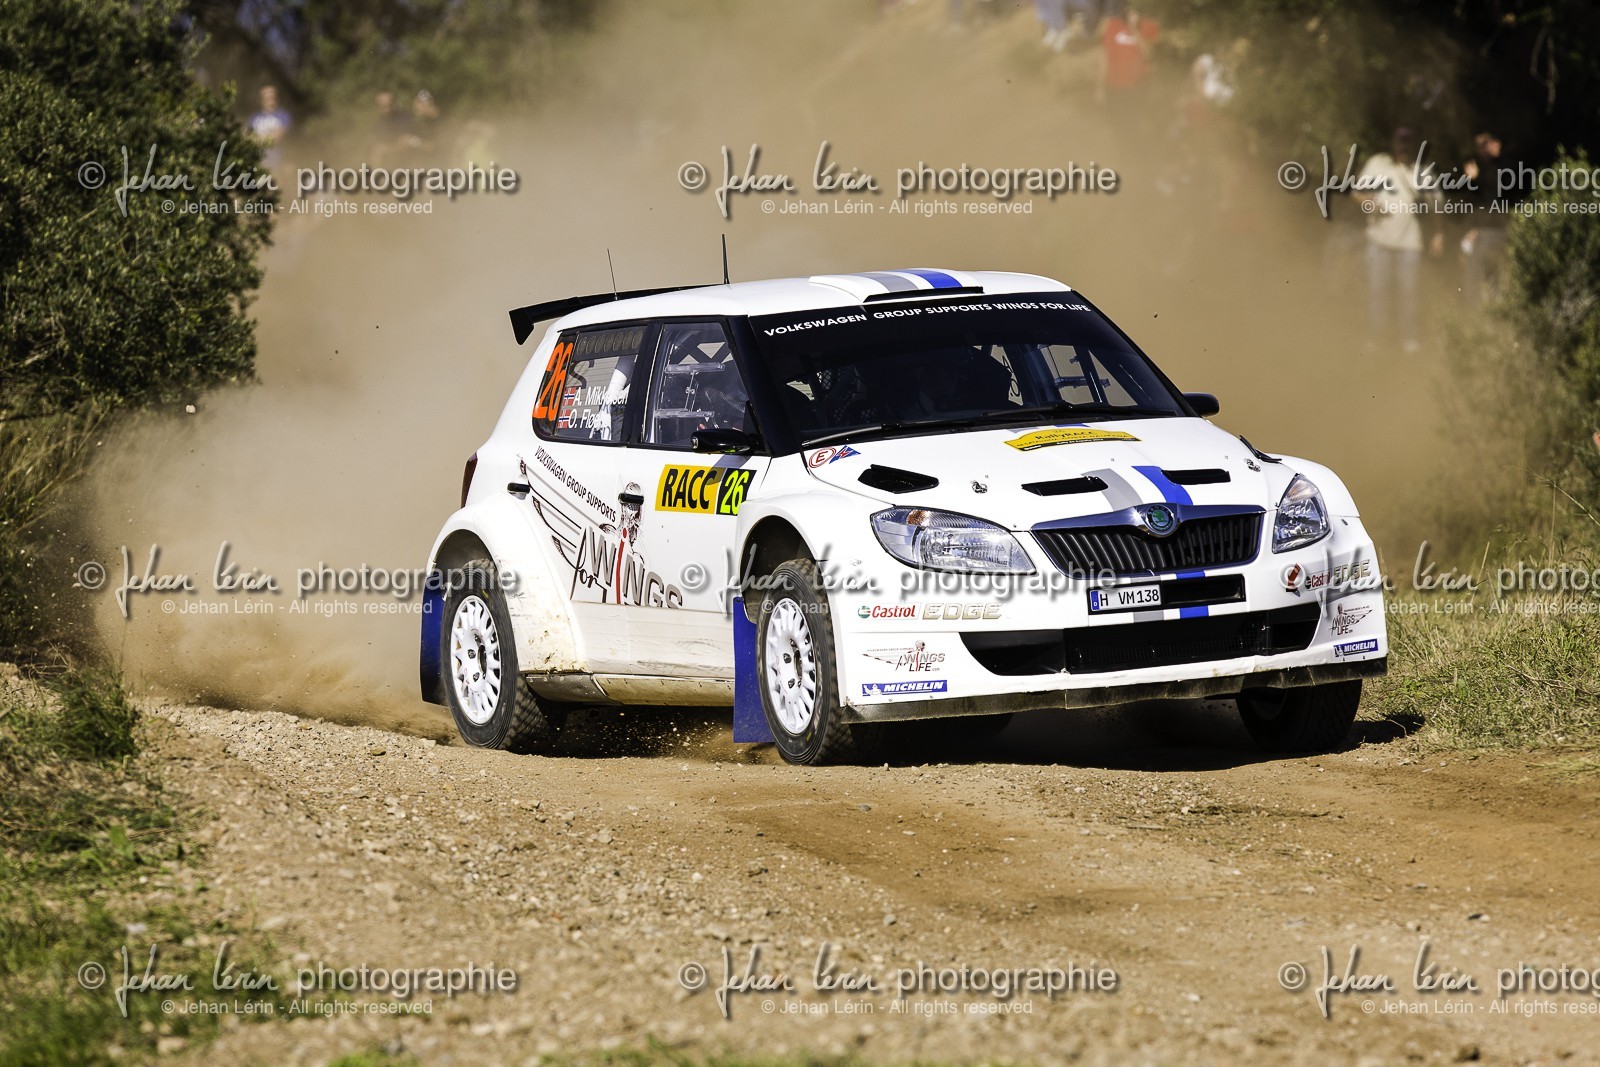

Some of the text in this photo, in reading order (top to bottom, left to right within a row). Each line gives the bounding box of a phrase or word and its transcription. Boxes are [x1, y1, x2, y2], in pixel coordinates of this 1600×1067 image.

[764, 302, 1092, 337] VOLKSWAGEN GROUP SUPPORTS WINGS FOR LIFE
[532, 342, 574, 421] 26
[572, 386, 582, 406] A.
[568, 409, 577, 429] O.
[534, 446, 616, 524] VOLKSWAGEN GROUP SUPPORTS
[661, 468, 717, 510] RACC
[720, 470, 748, 516] 26
[1100, 589, 1160, 606] H VM 138
[872, 602, 1002, 620] Castrol EDGE
[1344, 641, 1376, 653] MICHELIN
[883, 681, 944, 692] MICHELIN
